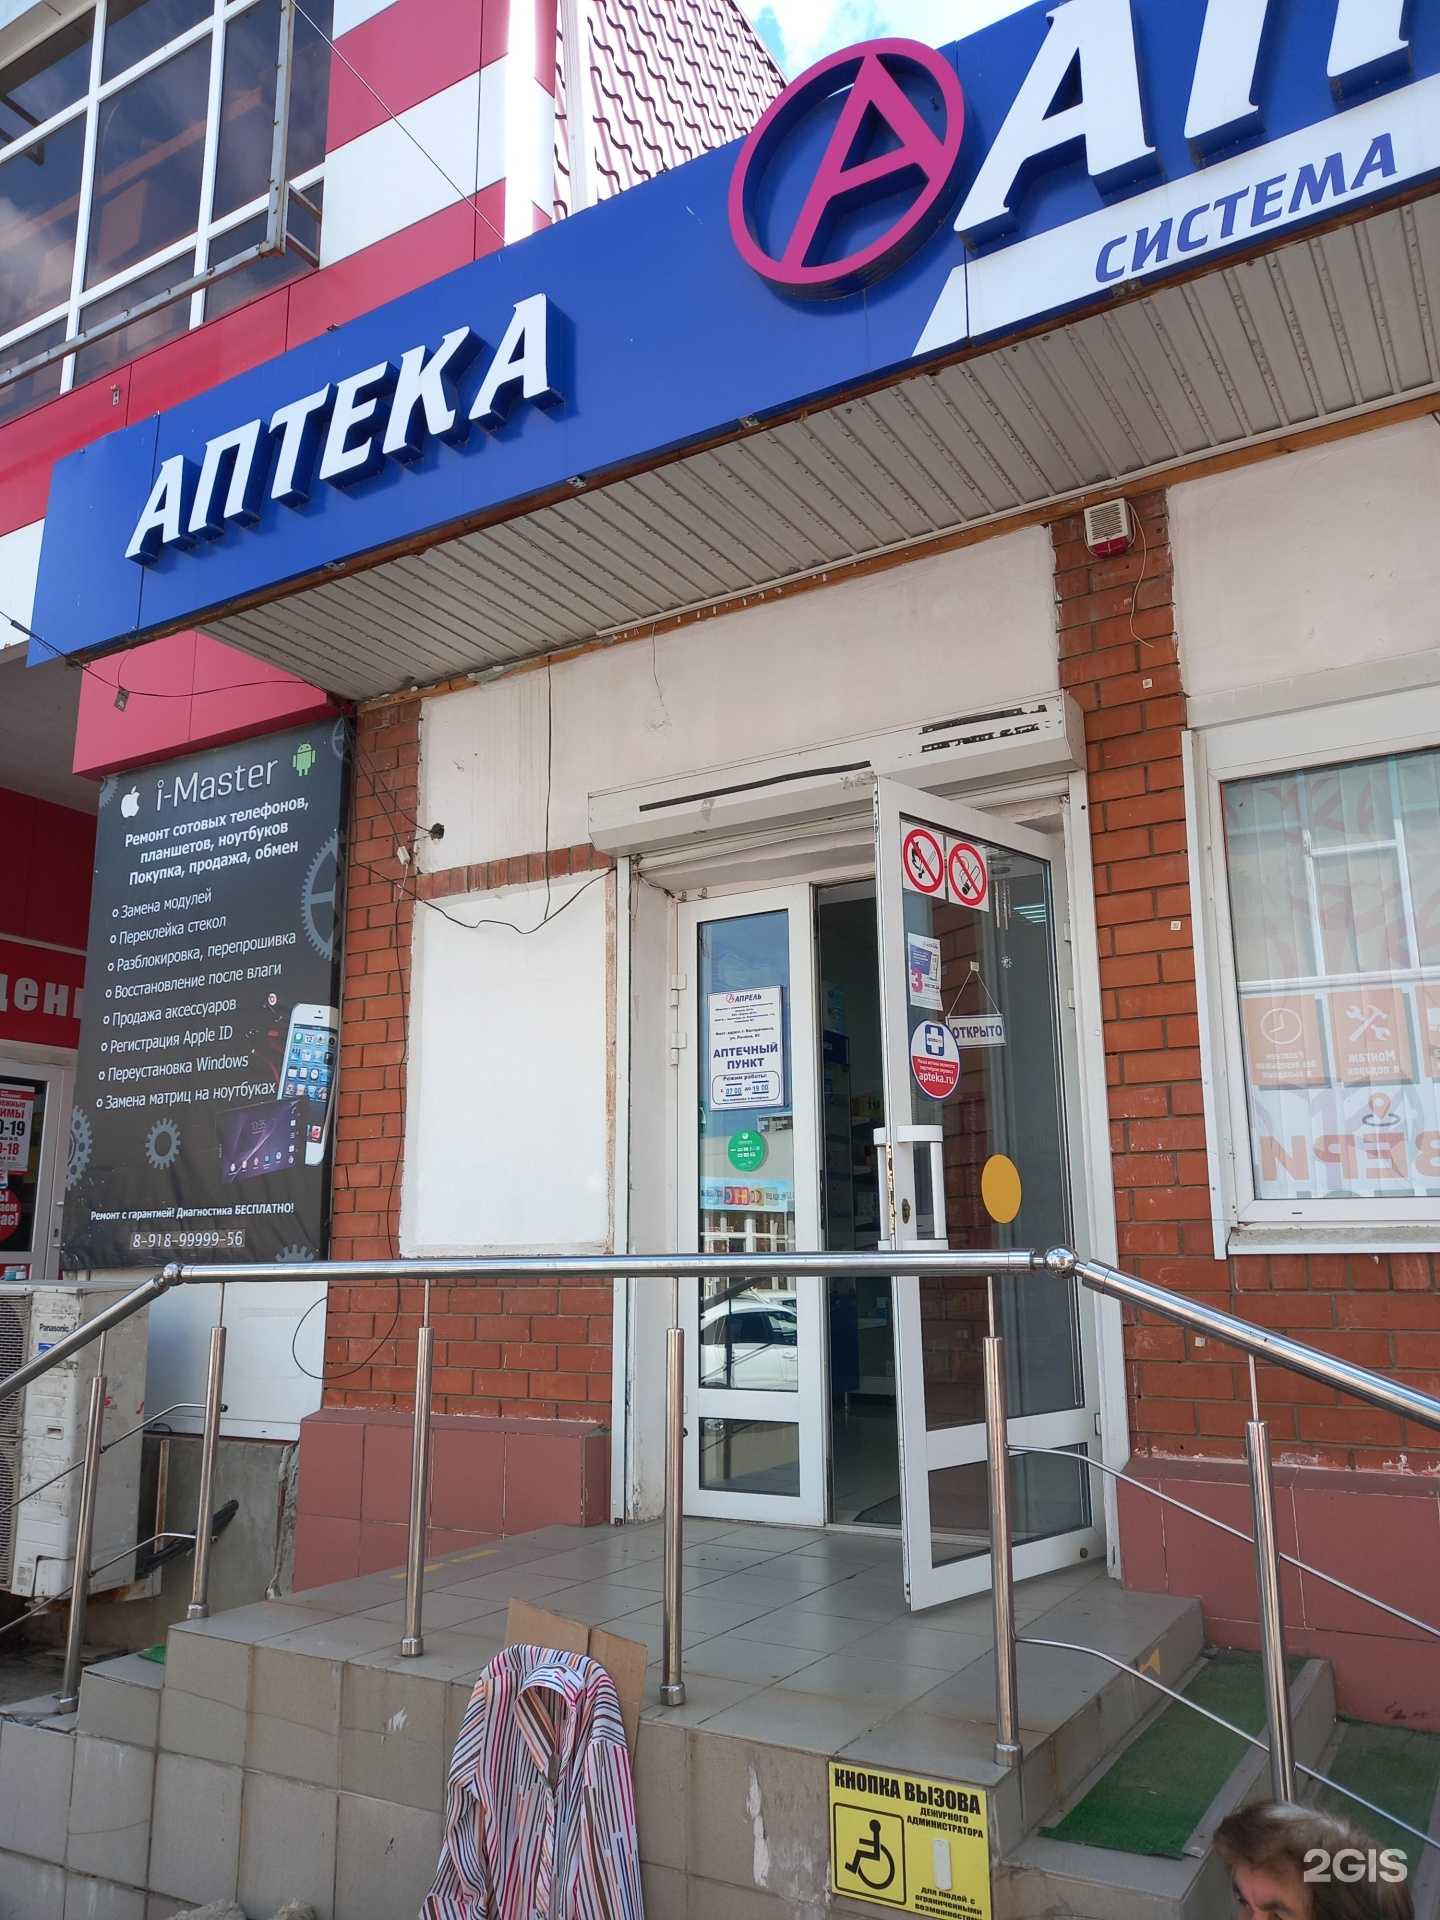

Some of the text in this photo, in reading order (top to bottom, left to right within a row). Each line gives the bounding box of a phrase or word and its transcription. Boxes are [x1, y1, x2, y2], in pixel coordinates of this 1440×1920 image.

[1095, 133, 1398, 283] СИСТЕМА
[124, 292, 550, 559] АПТЕКА
[156, 759, 279, 811] i-Master
[125, 797, 309, 847] Ремонт сотовых телефонов,
[140, 821, 289, 864] планшетов, ноутбуков
[129, 840, 299, 886] Покупка, продажа, обмен
[120, 888, 212, 918] Замена модулей
[119, 915, 226, 946] Переклейка стекол
[117, 931, 296, 972] Разблокировка, перепрошивка
[114, 962, 282, 999] Восстановление после влаги
[112, 998, 236, 1027] Продажа аксессуаров
[110, 1025, 233, 1054] Регистрация Apple ID
[952, 1025, 1002, 1039] ОТКРЫТО
[713, 1042, 778, 1058] АПТЕЧНЫЙ
[727, 1058, 765, 1069] ПУНКТ
[108, 1054, 249, 1083] Переустановка Windows
[919, 1072, 954, 1085] apteka.ru
[104, 1081, 276, 1110] Замена матриц на ноутбуках
[91, 1202, 295, 1222] Ремонт с гарантией! Диагностика БЕСПЛАТНО!
[132, 1231, 243, 1248] 8-918-99999-56
[834, 1768, 981, 1815] КНОПКА ВЫЗОВА
[907, 1815, 984, 1838] АДМИНИСТРАТОРА
[920, 1807, 969, 1824] ДЕЖУРНОГО
